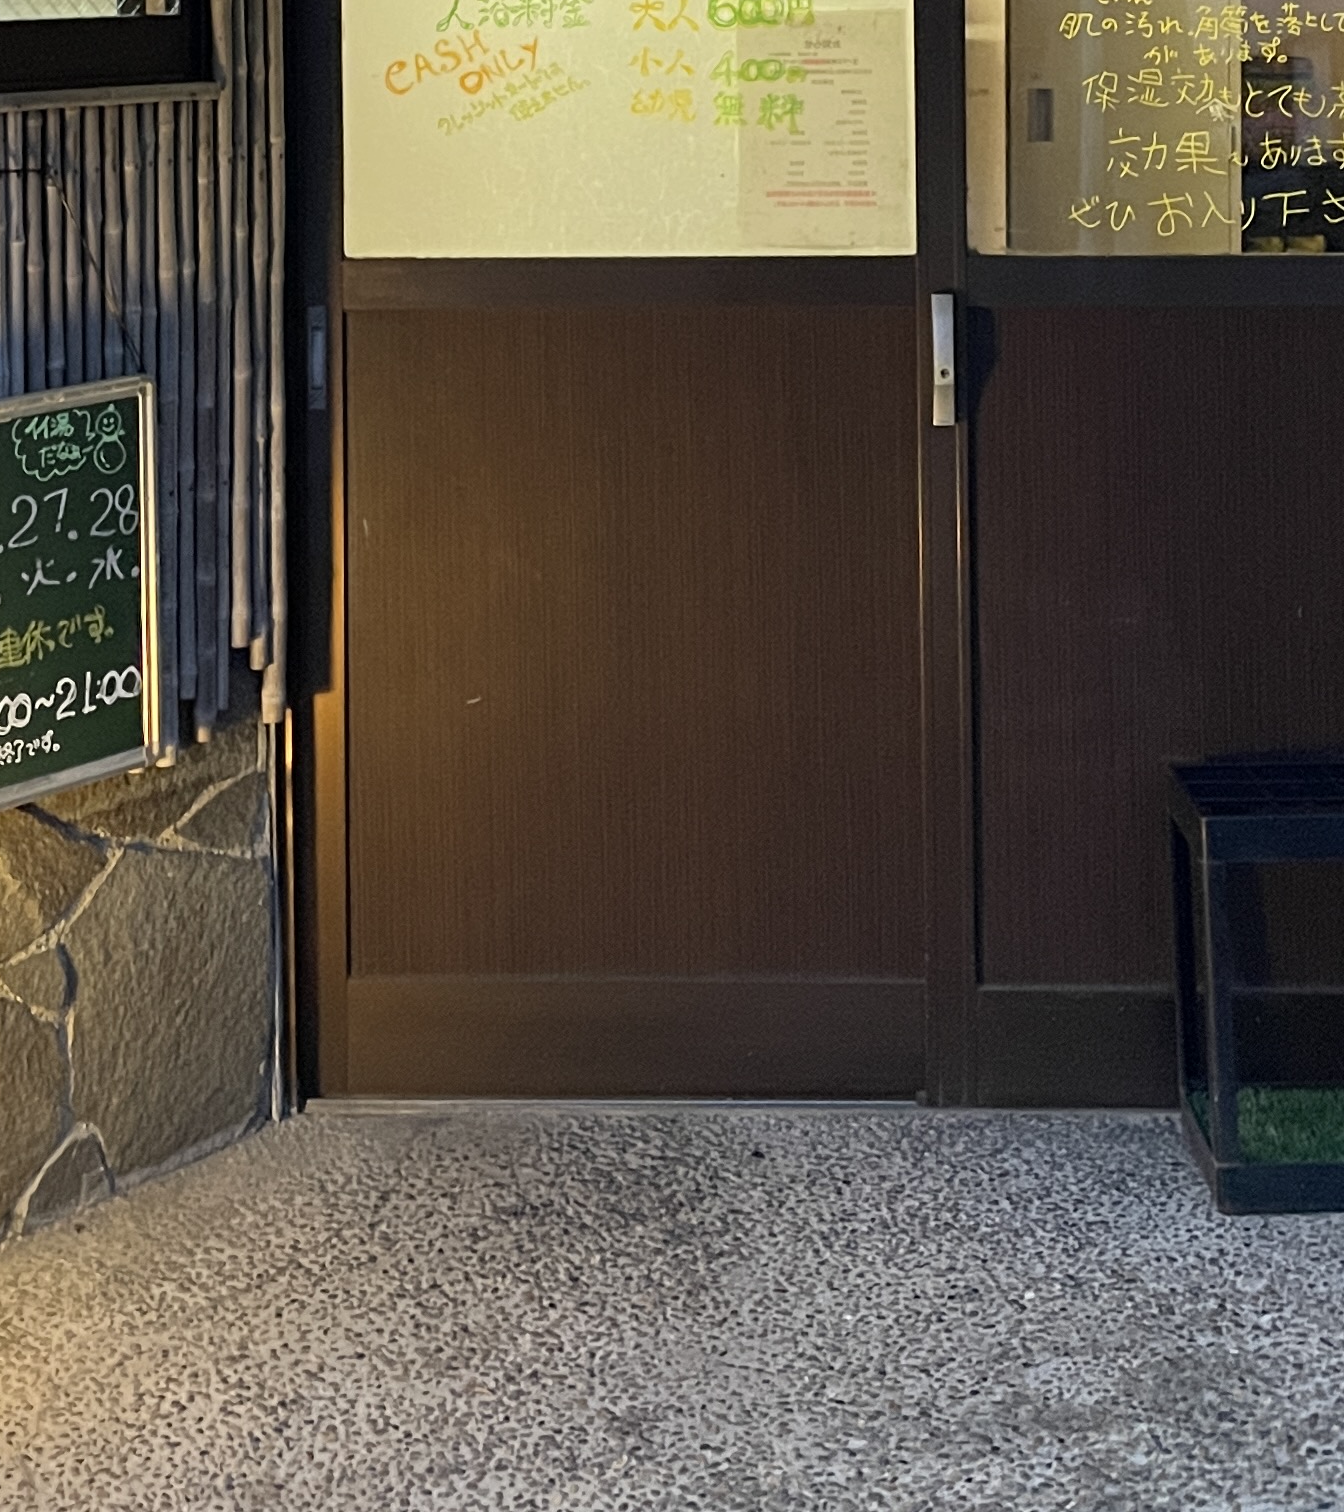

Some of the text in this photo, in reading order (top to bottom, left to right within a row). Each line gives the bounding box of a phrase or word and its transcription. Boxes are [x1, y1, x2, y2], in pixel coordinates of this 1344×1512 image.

[385, 29, 490, 95] CASH
[459, 36, 538, 95] ONLY
[629, 46, 695, 77] 小人
